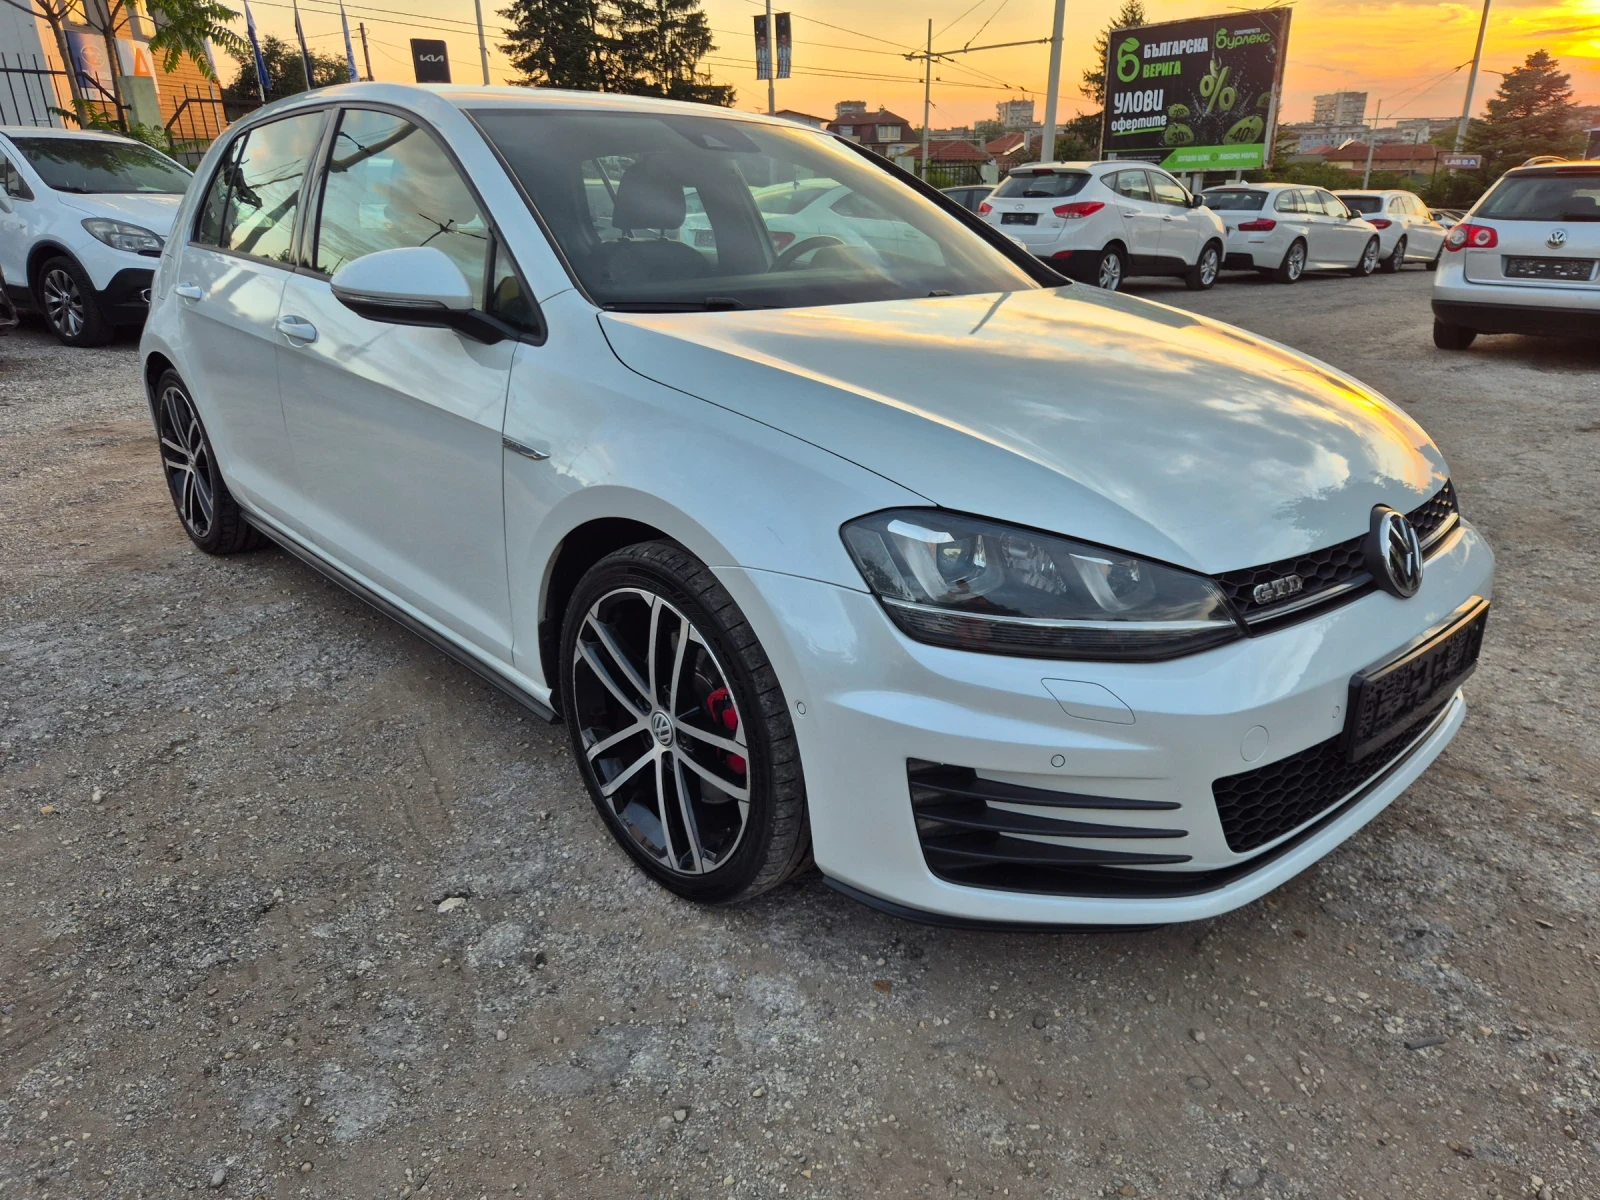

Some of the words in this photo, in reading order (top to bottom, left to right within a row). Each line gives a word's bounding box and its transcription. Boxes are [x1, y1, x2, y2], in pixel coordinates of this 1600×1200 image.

[1143, 37, 1209, 59] БЪЛГАРСКА
[1142, 60, 1182, 78] ВЕРИГА
[1113, 88, 1164, 114] УЛОВИ
[1111, 114, 1168, 133] офертите
[1253, 574, 1303, 605] GTD
